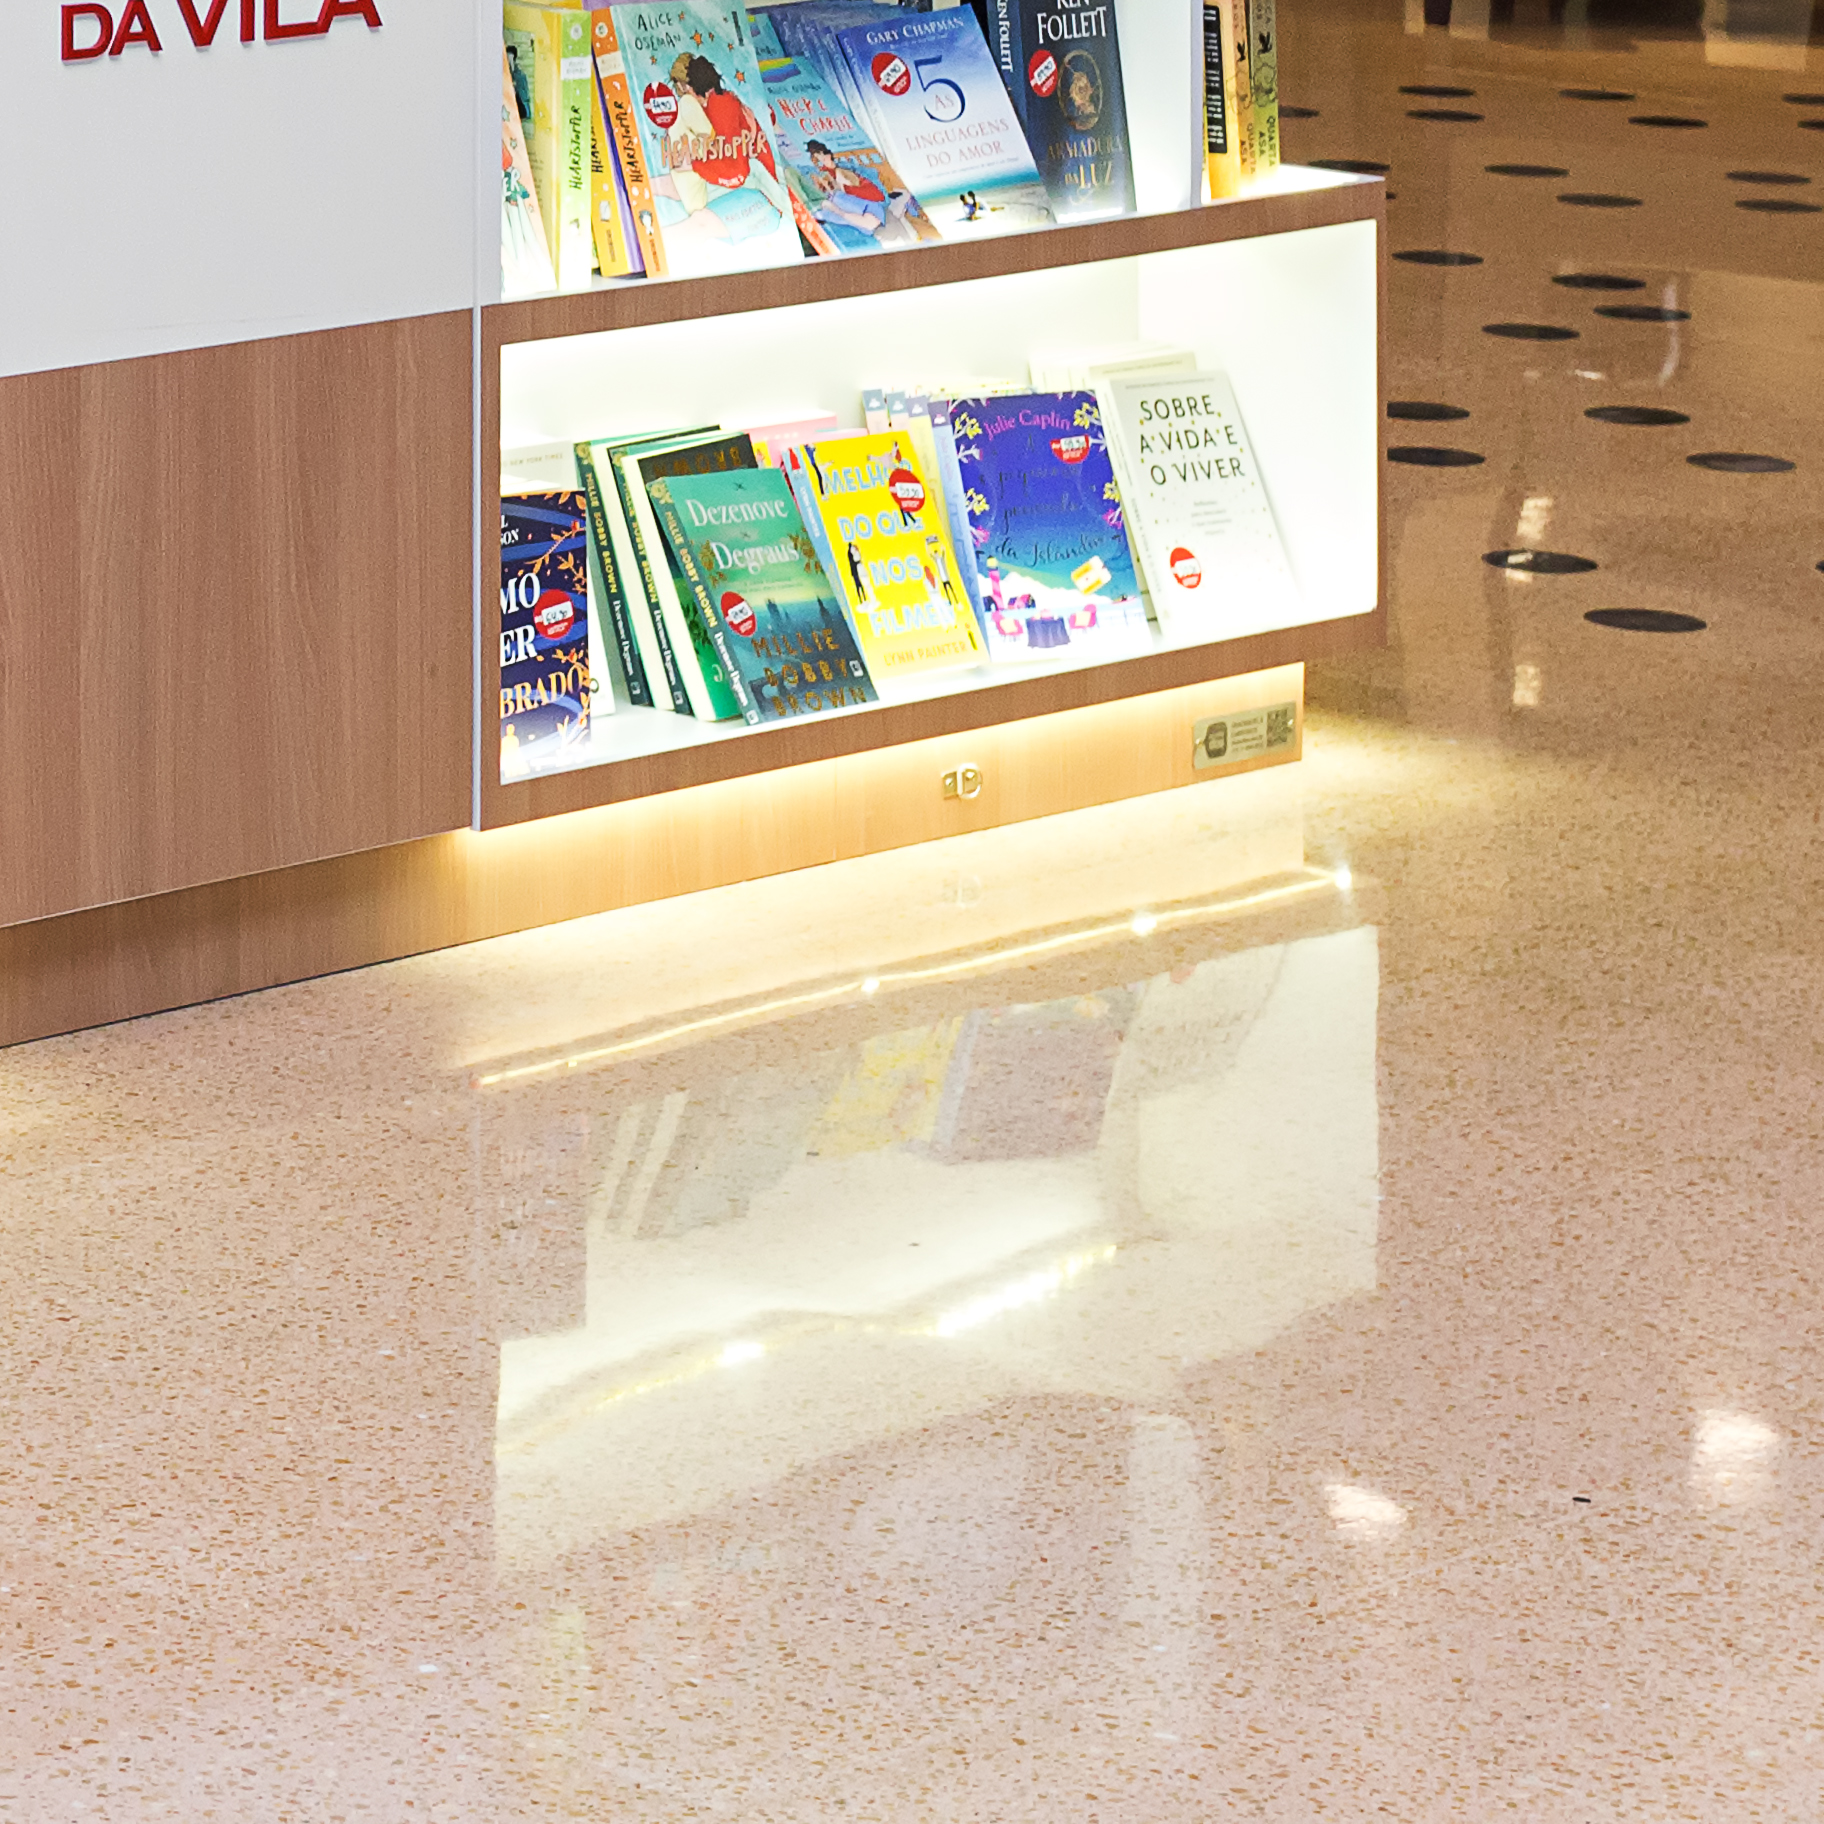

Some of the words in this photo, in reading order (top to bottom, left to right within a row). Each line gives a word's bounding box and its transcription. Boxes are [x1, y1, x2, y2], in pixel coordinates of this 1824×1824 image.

[637, 12, 674, 32] ALICE
[865, 29, 899, 46] GARY
[902, 16, 965, 40] CHAPMAN
[1037, 5, 1108, 43] FOLLETT
[634, 33, 682, 51] OSEMAN
[997, 21, 1014, 74] FOLLETT
[914, 54, 966, 123] 5
[778, 97, 812, 118] NICK
[798, 115, 856, 136] CHARLIE
[905, 119, 1009, 152] LINGUAGENS
[1265, 115, 1276, 167] QUARTA
[568, 104, 583, 190] HEARTSTOPPER
[613, 100, 644, 185] HEARTSTOPPER
[660, 129, 769, 170] HEARTSTOPPER
[926, 150, 951, 168] DO
[957, 139, 1004, 164] AMOR
[1048, 135, 1123, 164] ARMADURA
[1257, 130, 1267, 157] ASA
[1139, 394, 1215, 421] SOBRE
[984, 409, 1017, 440] Julie
[1018, 407, 1072, 434] Caplin
[1139, 432, 1151, 455] A
[1160, 427, 1216, 451] VIDA
[1226, 425, 1238, 446] E
[1150, 464, 1168, 486] O
[1173, 455, 1246, 484] VIVER
[685, 497, 788, 528] Dezenove
[839, 515, 870, 542] DO
[665, 509, 684, 546] MILLIE
[679, 545, 699, 584] BOBBY
[694, 584, 718, 628] BROWN
[710, 539, 800, 574] Degraus
[869, 555, 923, 585] NOS
[751, 628, 840, 658] MILLIE
[884, 650, 915, 668] LYNN
[917, 640, 968, 662] PAINTER
[763, 657, 851, 688] BOBBY
[771, 686, 867, 717] BROWN
